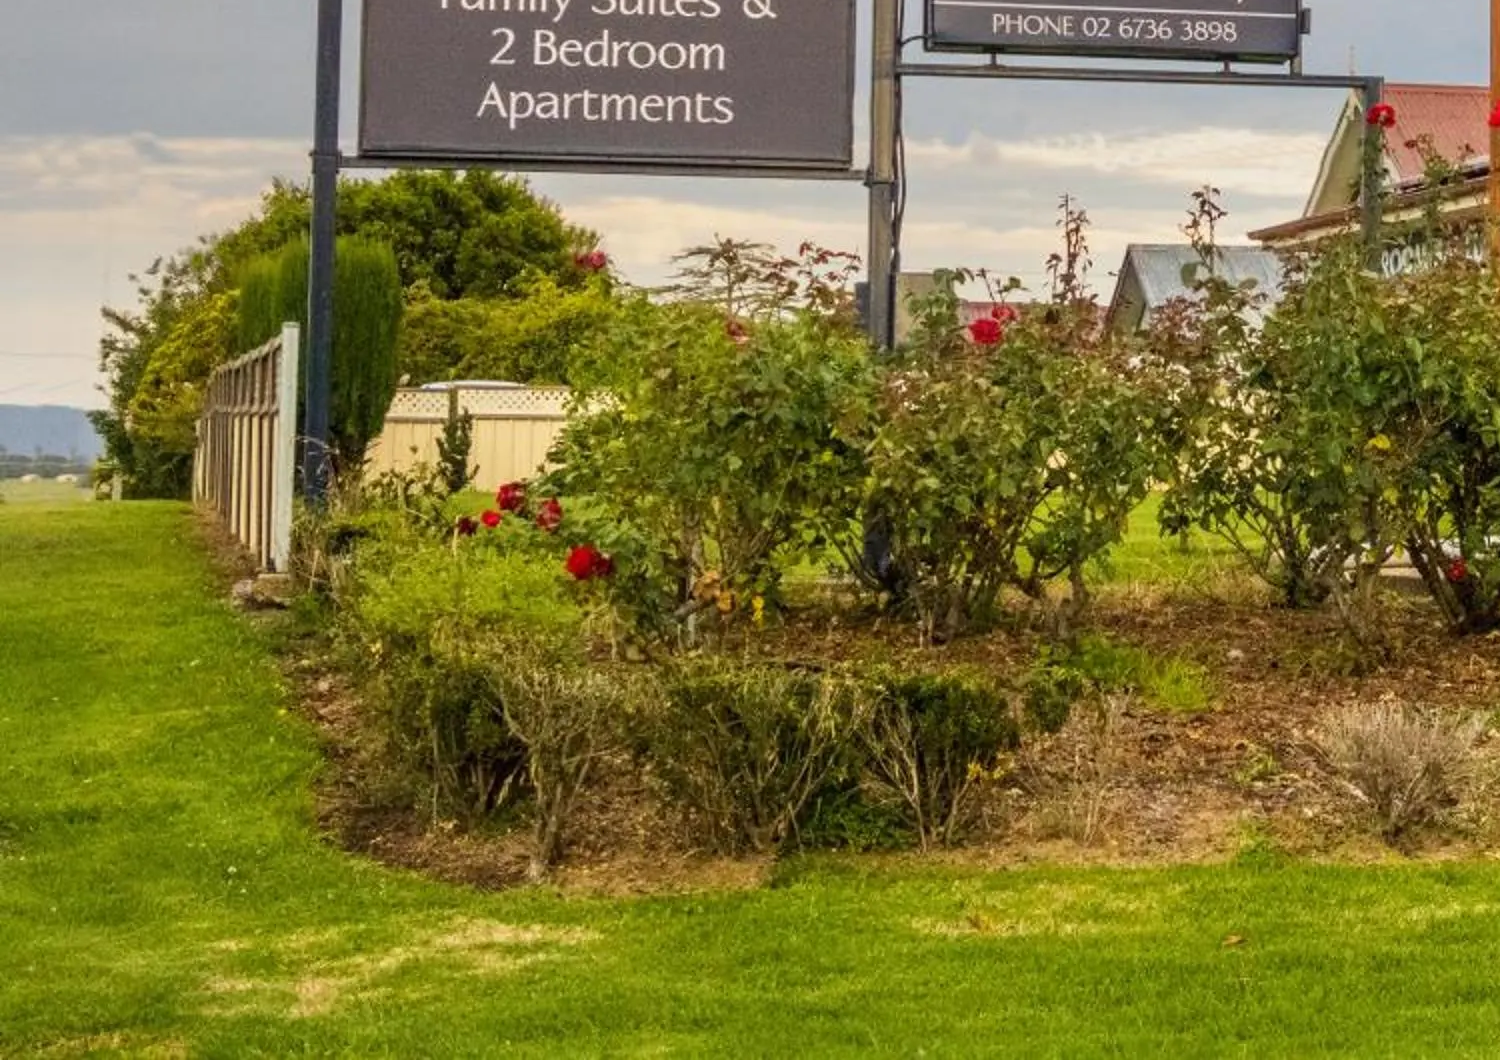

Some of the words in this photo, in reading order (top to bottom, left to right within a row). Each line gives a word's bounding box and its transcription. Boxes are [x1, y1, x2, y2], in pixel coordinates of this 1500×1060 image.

[489, 27, 516, 66] 2
[533, 29, 726, 70] Bedroom
[992, 13, 1076, 37] PHONE
[1082, 17, 1112, 38] 02
[1118, 18, 1173, 40] 6736
[1179, 20, 1238, 43] 3898
[476, 81, 735, 130] Apartments
